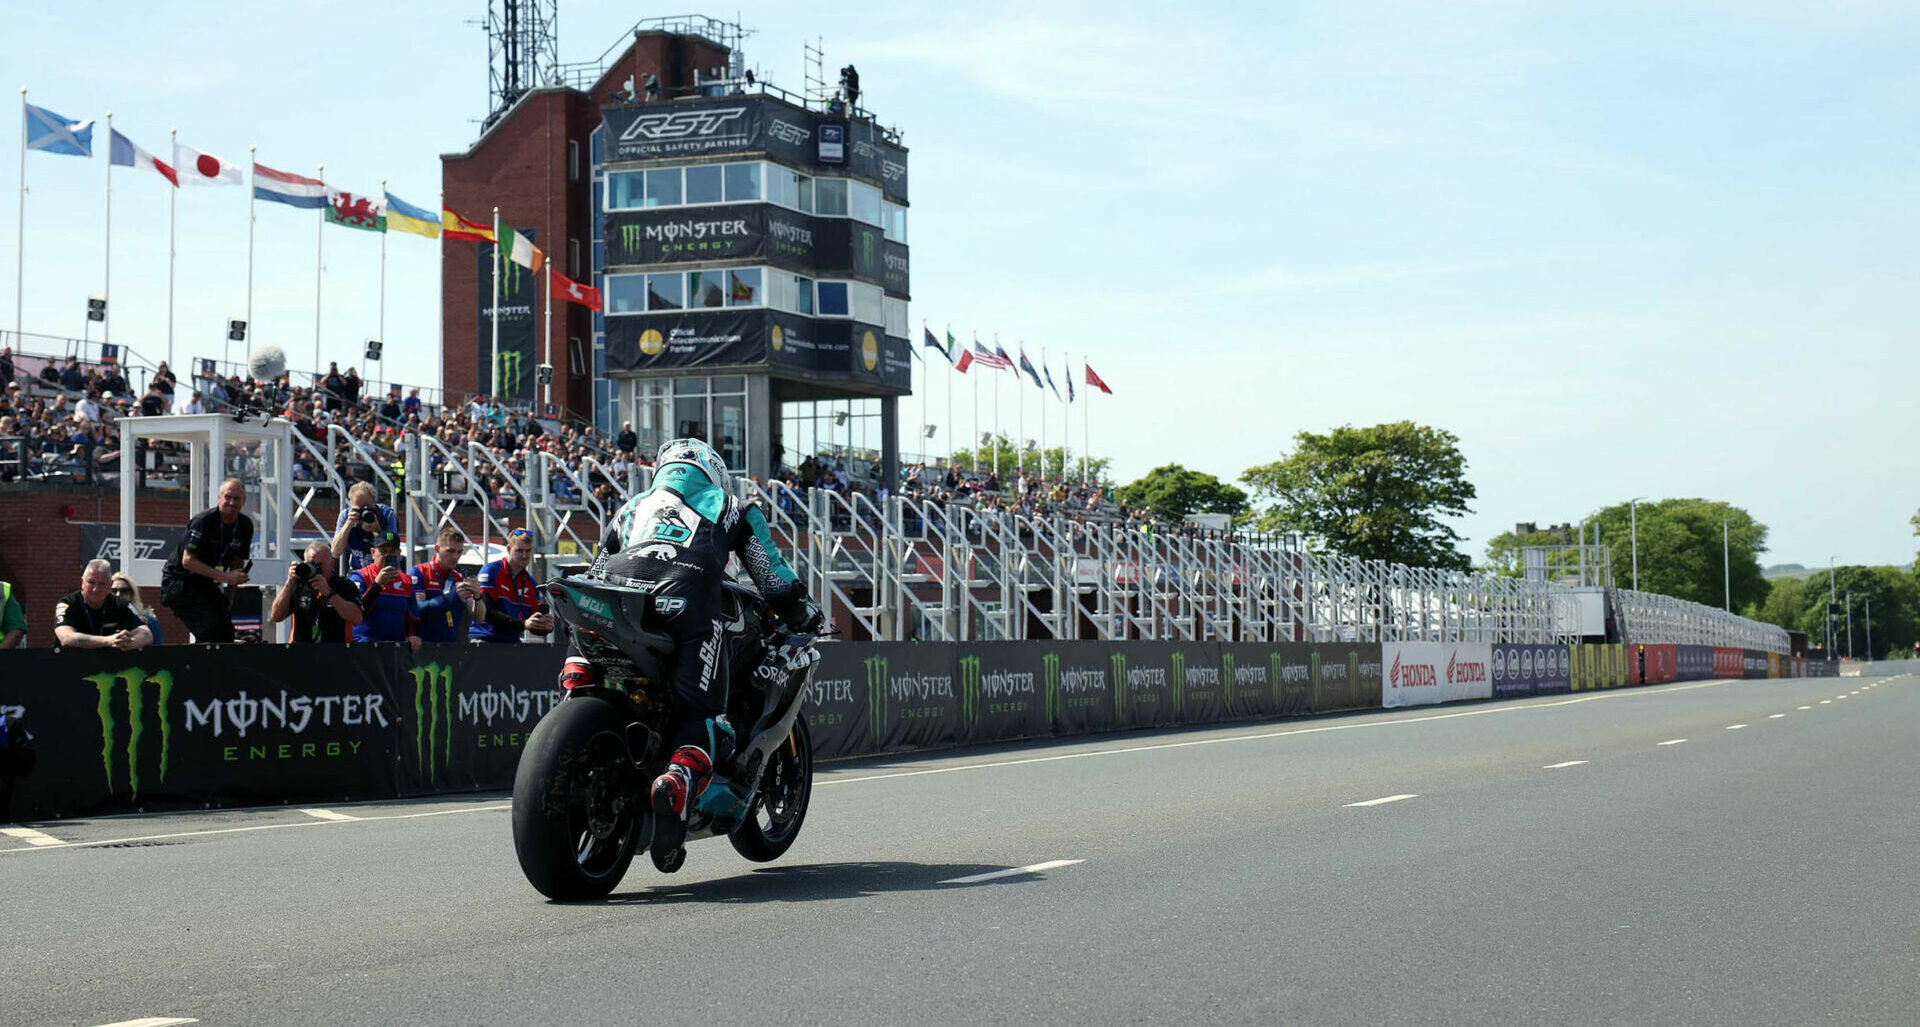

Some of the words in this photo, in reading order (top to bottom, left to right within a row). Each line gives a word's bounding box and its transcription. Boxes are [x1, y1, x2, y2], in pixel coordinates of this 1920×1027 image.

[619, 107, 747, 140] RST
[768, 119, 810, 146] RST
[618, 143, 662, 155] OFFICIAL
[665, 140, 700, 152] SAFETY
[704, 137, 748, 149] PARTNER
[645, 219, 749, 242] MONSTER
[661, 240, 733, 253] ENERGY
[96, 537, 166, 559] RT
[981, 668, 1035, 699] MONSTER
[1060, 665, 1106, 694] MONSTER
[1126, 664, 1167, 691] MONSTER
[1185, 664, 1220, 688] MONSTER
[1401, 664, 1438, 688] HONDA
[1456, 662, 1486, 684] HONDA
[890, 671, 954, 702] MONSTER
[184, 689, 389, 738] MONSTER
[900, 707, 945, 719] ENERGY
[223, 741, 362, 761] ENERGY
